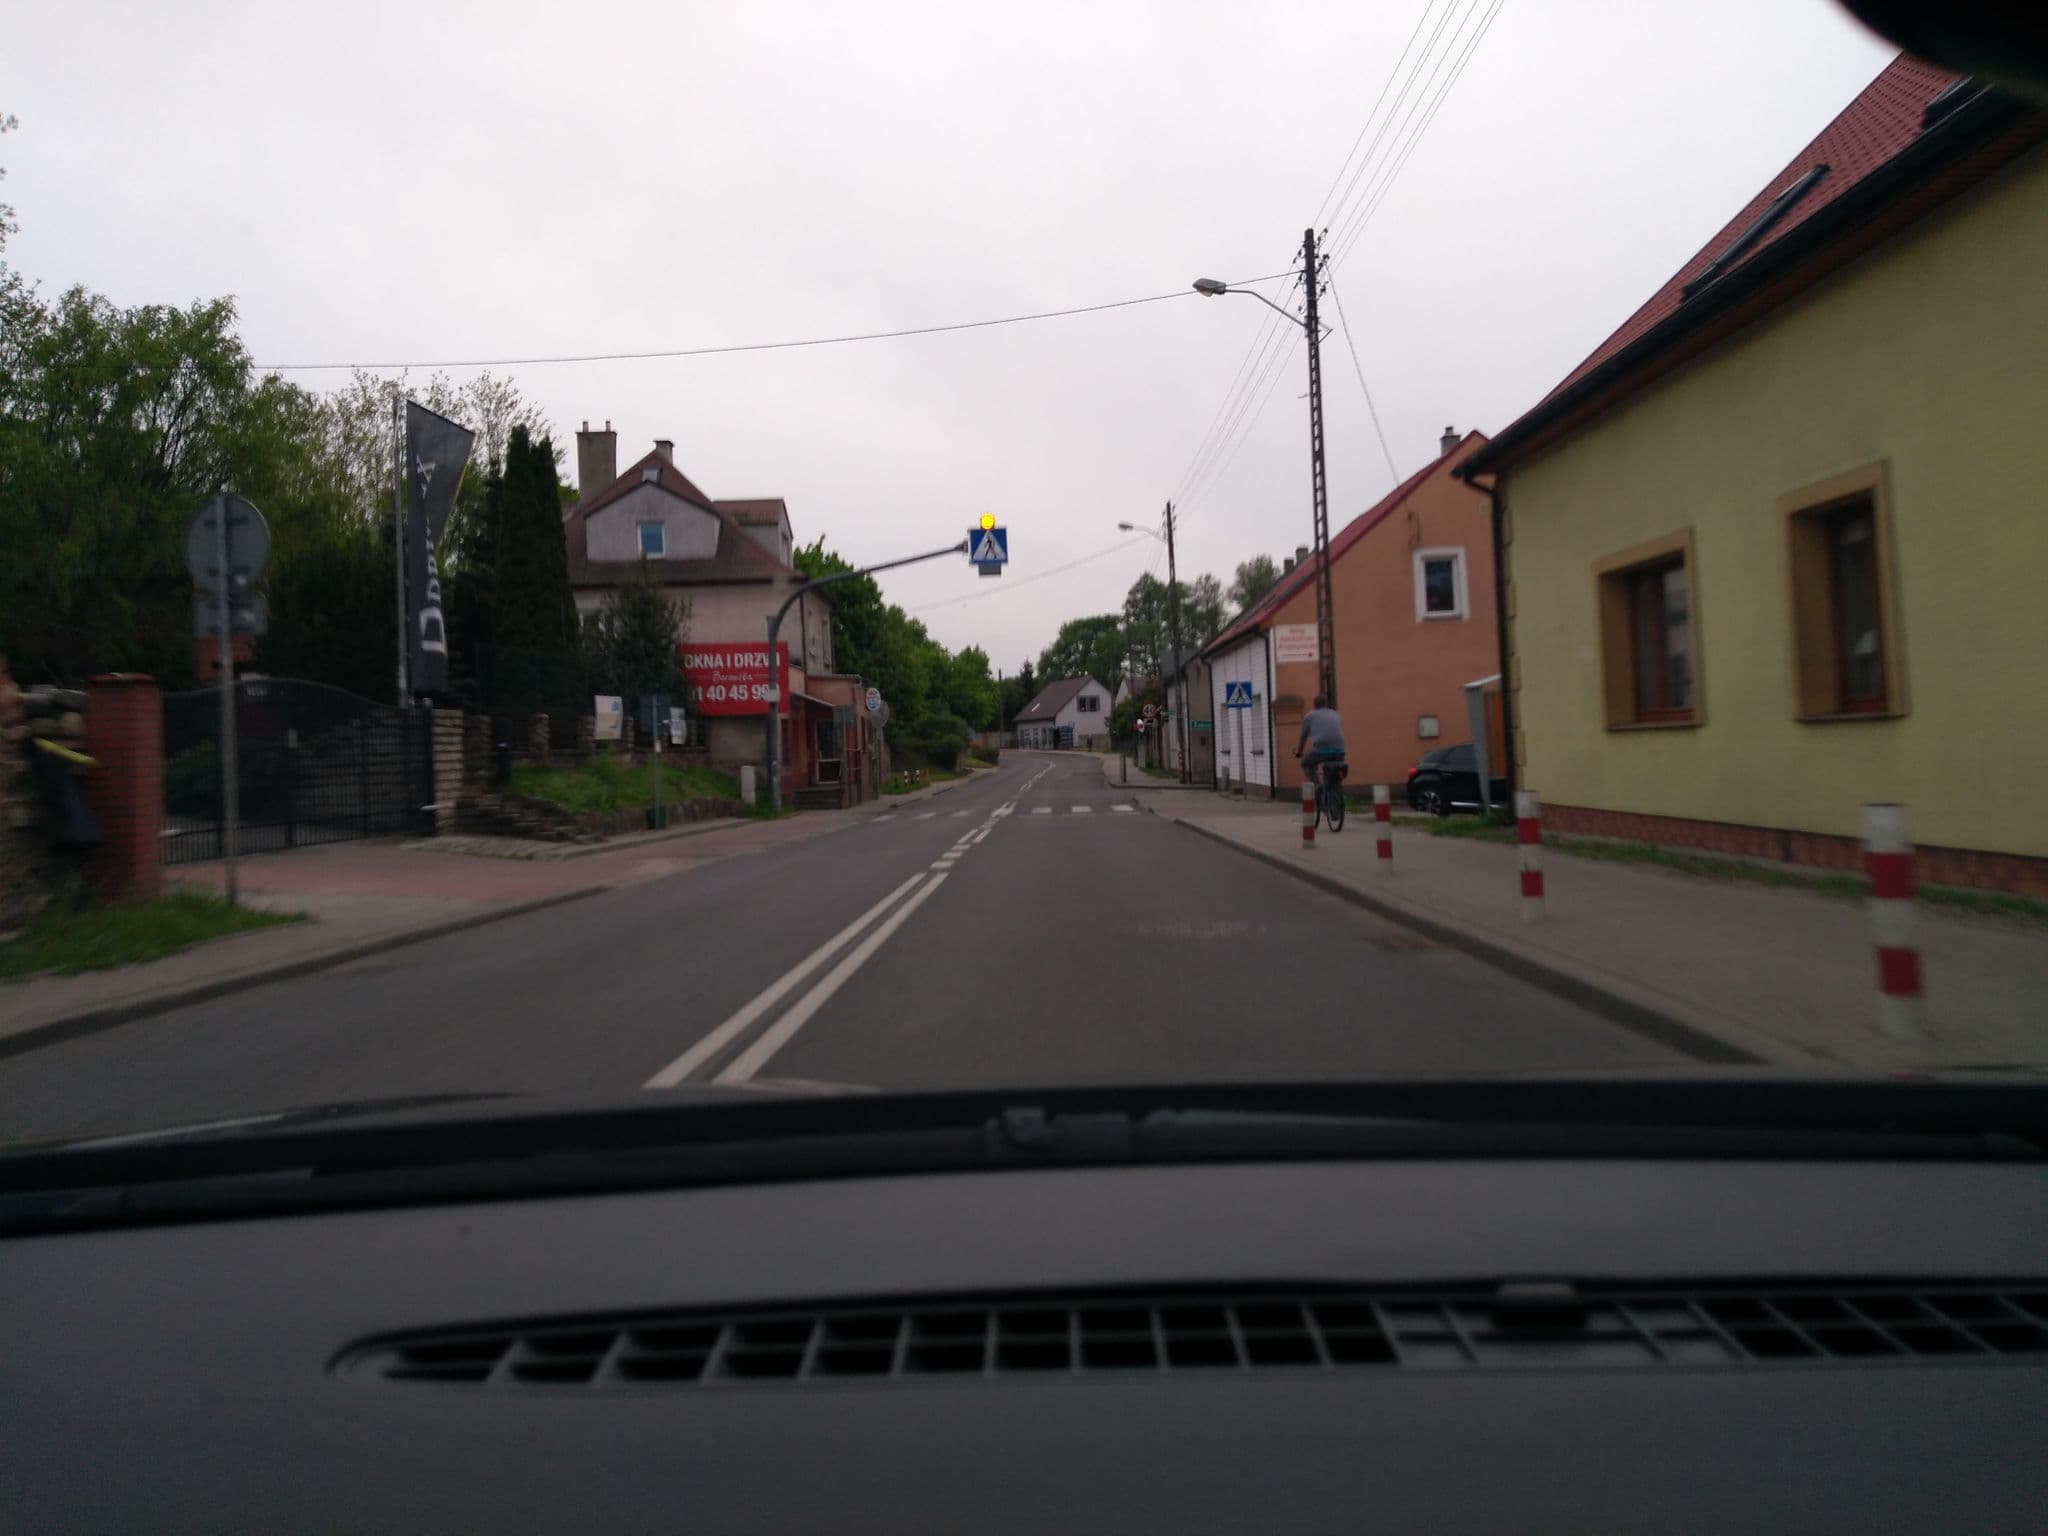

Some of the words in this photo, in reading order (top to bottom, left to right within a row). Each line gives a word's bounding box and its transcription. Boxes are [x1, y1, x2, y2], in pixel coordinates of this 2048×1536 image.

[685, 654, 724, 668] OKNA
[727, 653, 731, 667] I
[706, 685, 727, 702] 40
[729, 684, 749, 701] 45
